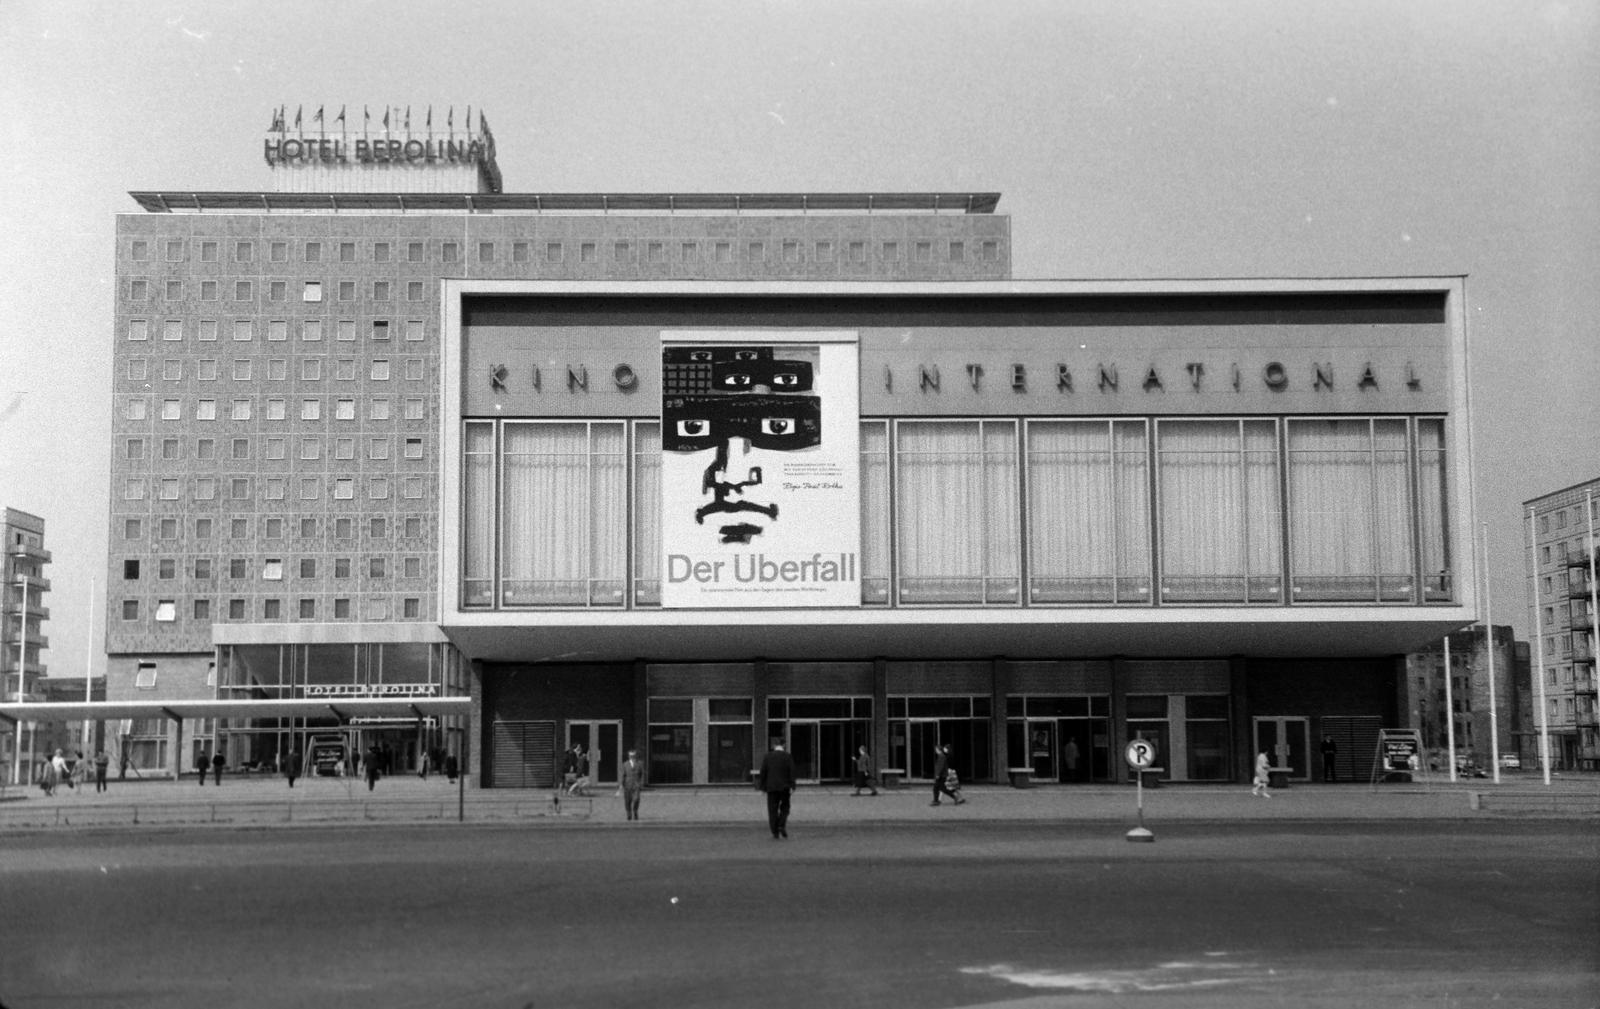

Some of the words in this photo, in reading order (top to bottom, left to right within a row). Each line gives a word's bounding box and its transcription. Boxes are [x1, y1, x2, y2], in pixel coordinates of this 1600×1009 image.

[264, 138, 347, 160] HOTEL
[355, 138, 481, 160] BEROLINA
[489, 363, 639, 394] KINO
[884, 361, 1422, 394] INTERNATIONAL
[668, 554, 725, 583] Der
[734, 553, 855, 582] Überfall
[304, 685, 349, 695] HOTEL
[361, 684, 436, 695] BEROLINA
[1137, 745, 1147, 764] P
